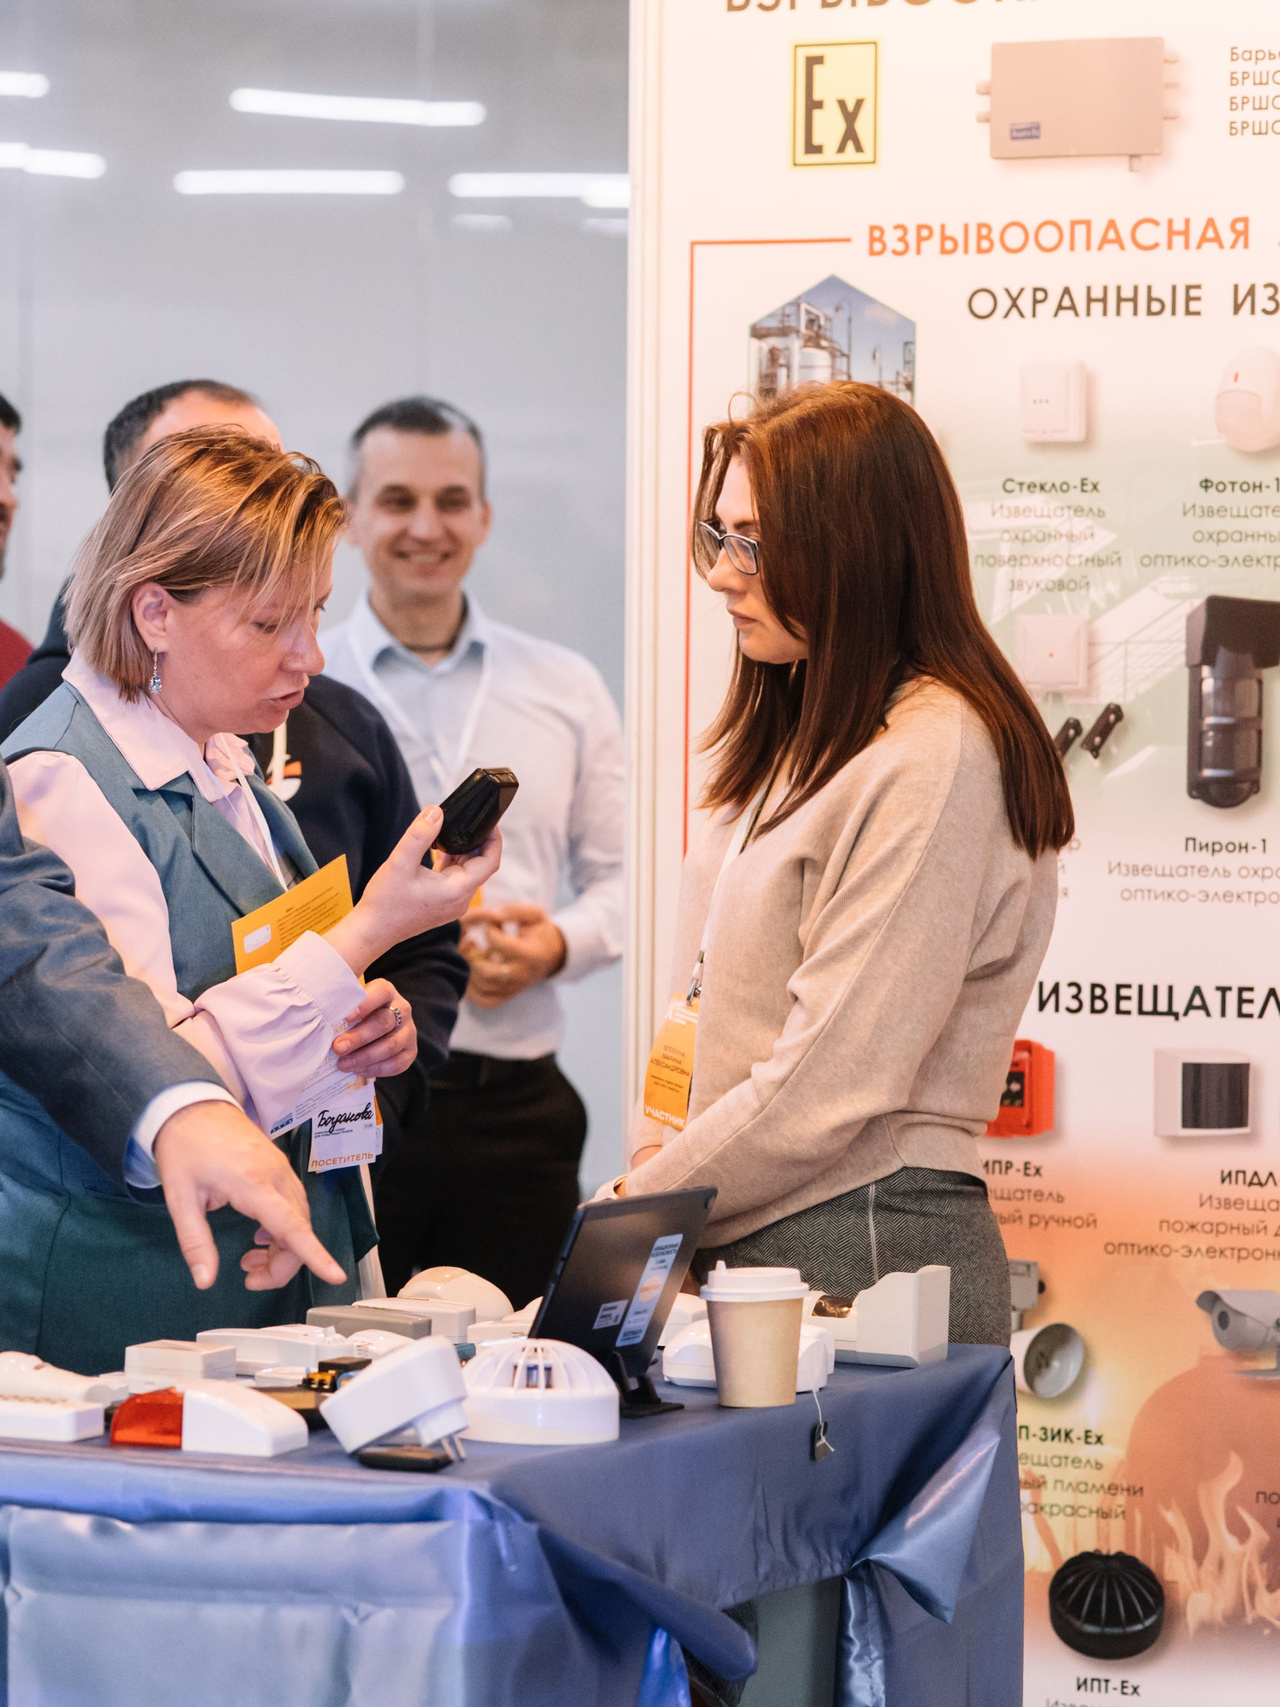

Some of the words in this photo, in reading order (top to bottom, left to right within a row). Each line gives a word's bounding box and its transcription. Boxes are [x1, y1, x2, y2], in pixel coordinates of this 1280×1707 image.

[1230, 46, 1280, 65] Барь
[804, 55, 865, 155] Ex
[868, 217, 1251, 257] ВЗРЫВООПАСНАЯ
[967, 284, 1204, 320] ОХРАННЫЕ
[1233, 282, 1280, 316] ИЗ
[990, 503, 1106, 519] Извещатель
[1000, 526, 1096, 546] охранный
[974, 551, 1122, 570] поверхностный
[1009, 575, 1091, 594] звуковой
[1184, 837, 1267, 856] Пирон-1
[1107, 860, 1232, 879] Извещатель
[644, 1105, 686, 1128] УЧАСТНИК
[311, 1152, 374, 1168] ПОСЕТИТЕЛЬ
[989, 1187, 1065, 1204] щатель
[996, 1209, 1023, 1226] ый
[1028, 1211, 1098, 1231] ручной
[1158, 1218, 1268, 1238] пожарный
[1053, 1479, 1145, 1498] пламени
